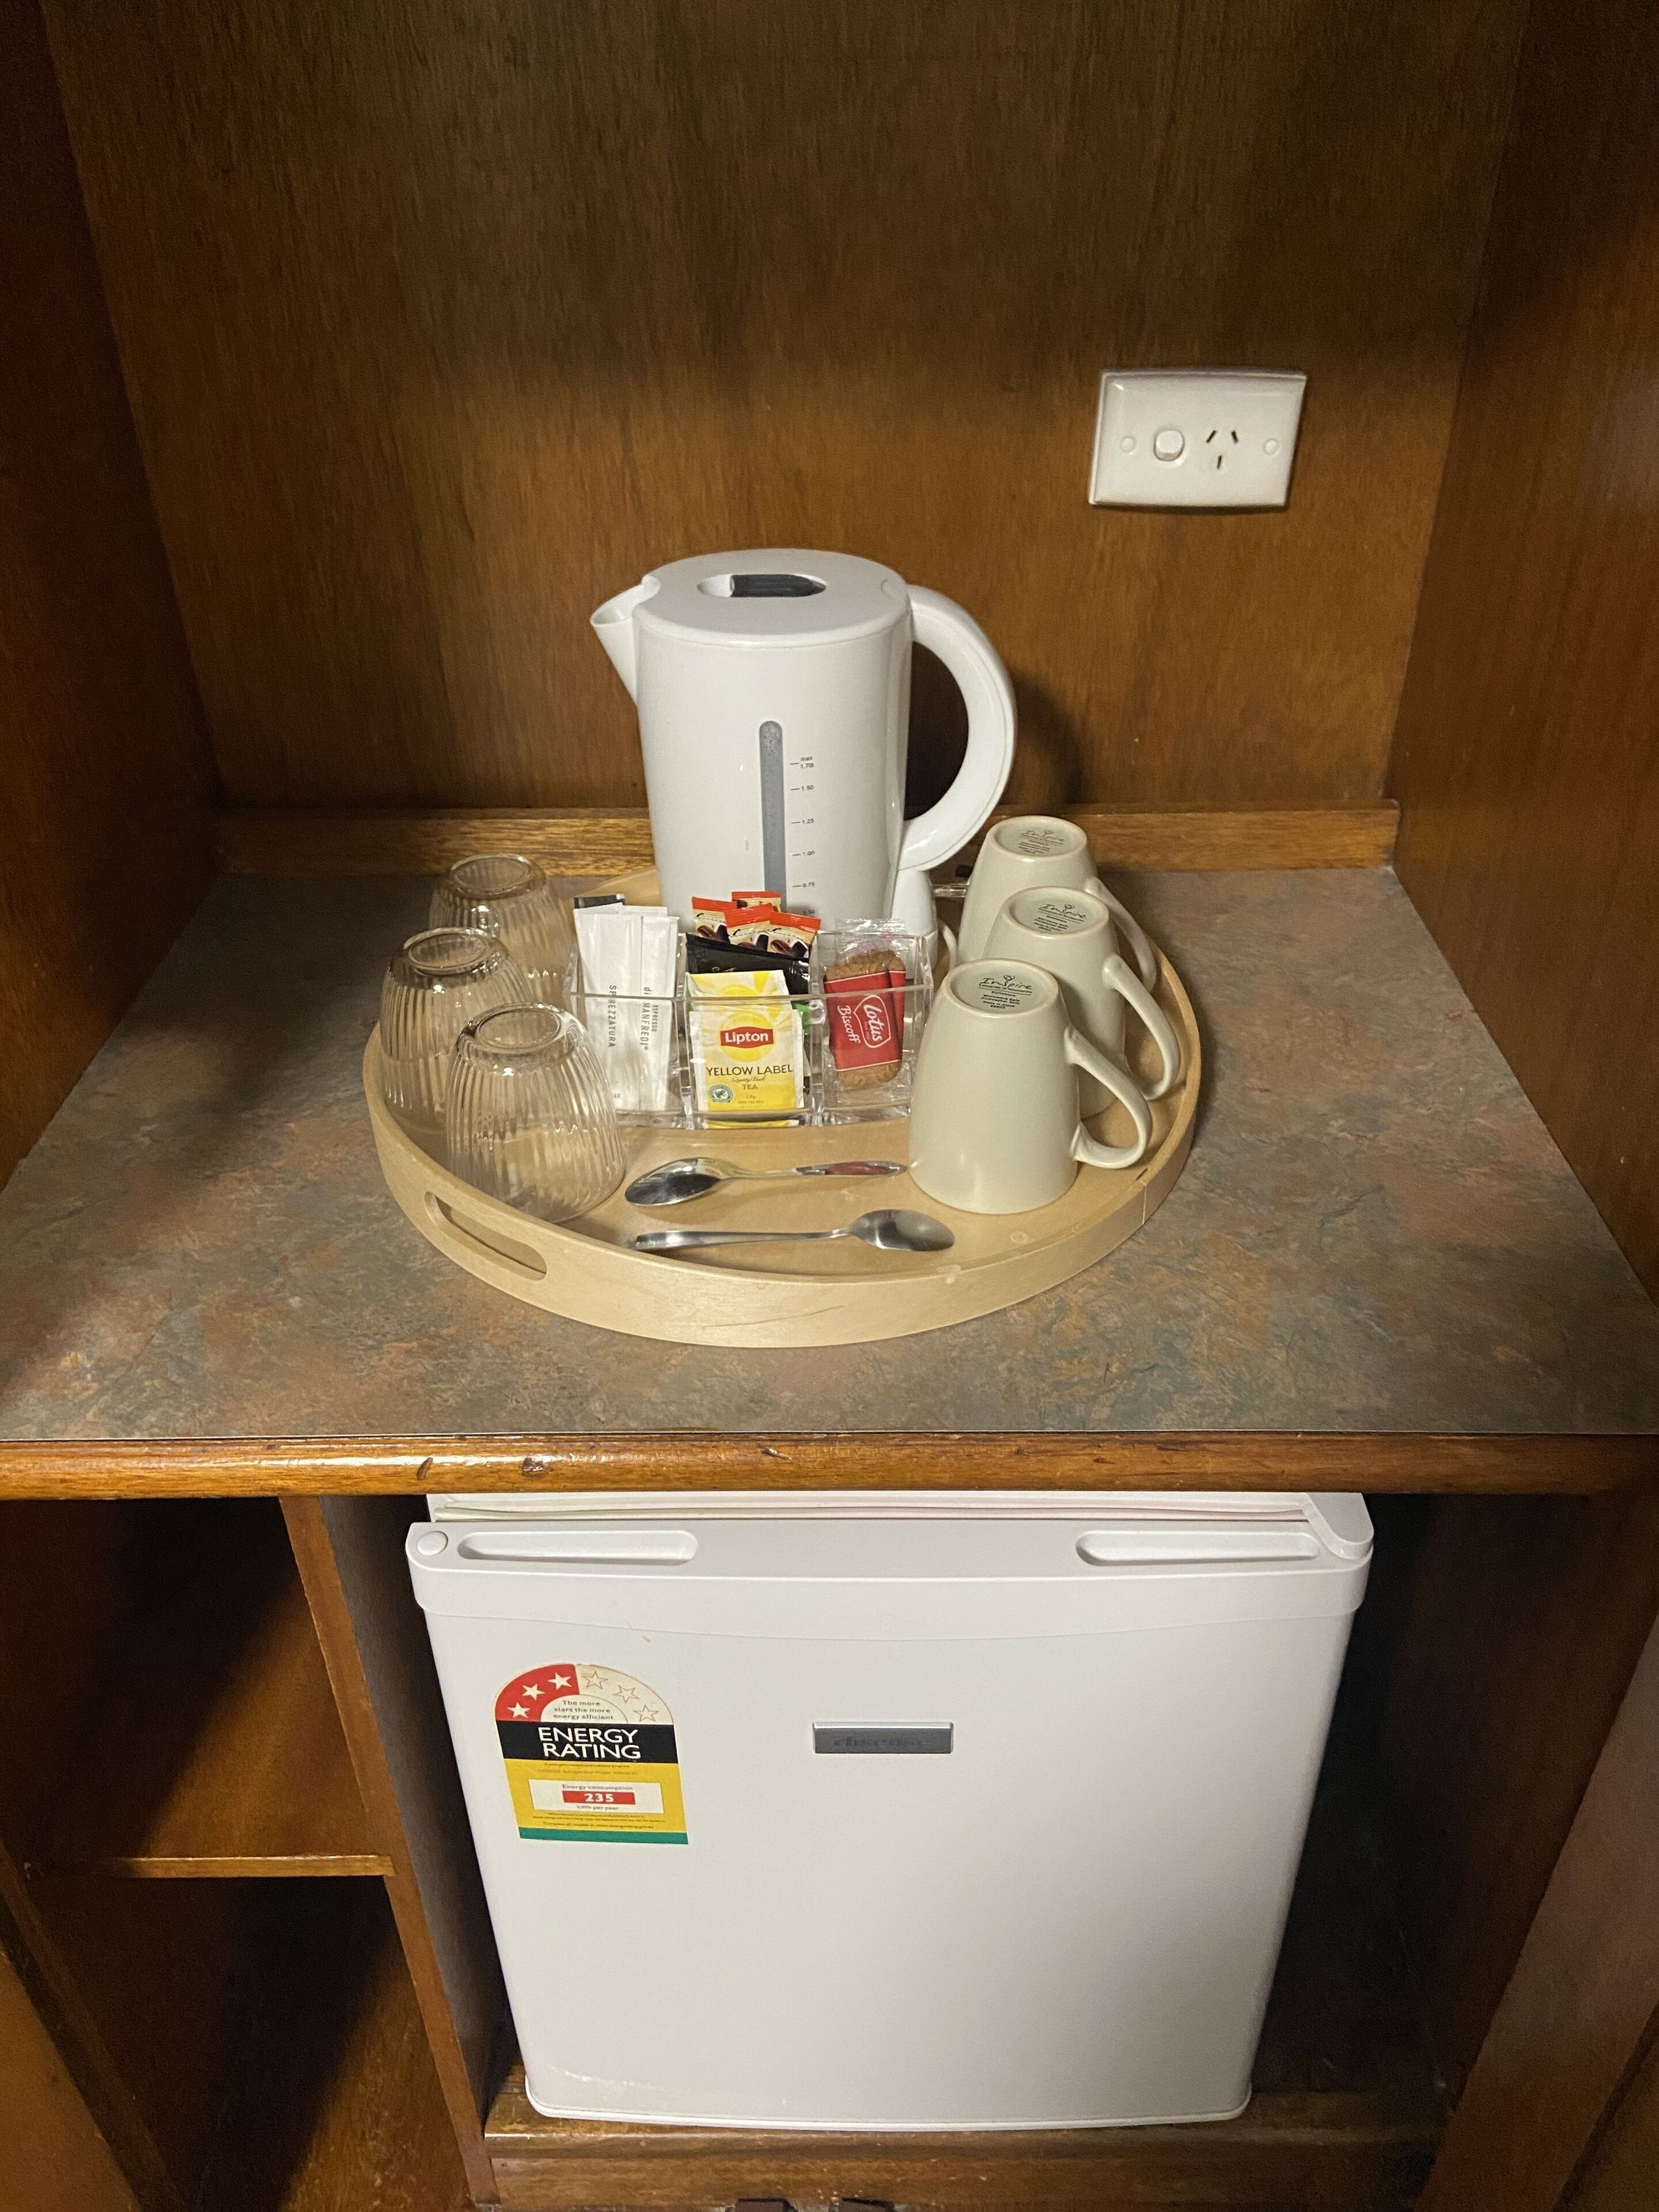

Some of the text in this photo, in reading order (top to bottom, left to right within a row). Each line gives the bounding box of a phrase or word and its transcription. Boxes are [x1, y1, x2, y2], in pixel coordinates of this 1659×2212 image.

[644, 987, 653, 995] di
[837, 1005, 861, 1044] Biscoff
[863, 1004, 885, 1041] Lotus
[725, 1032, 769, 1044] Lipton
[706, 1064, 794, 1076] YELLOW LABEL
[538, 1727, 638, 1743] ENERGY
[543, 1743, 641, 1759] RATING
[584, 1793, 615, 1802] 235
